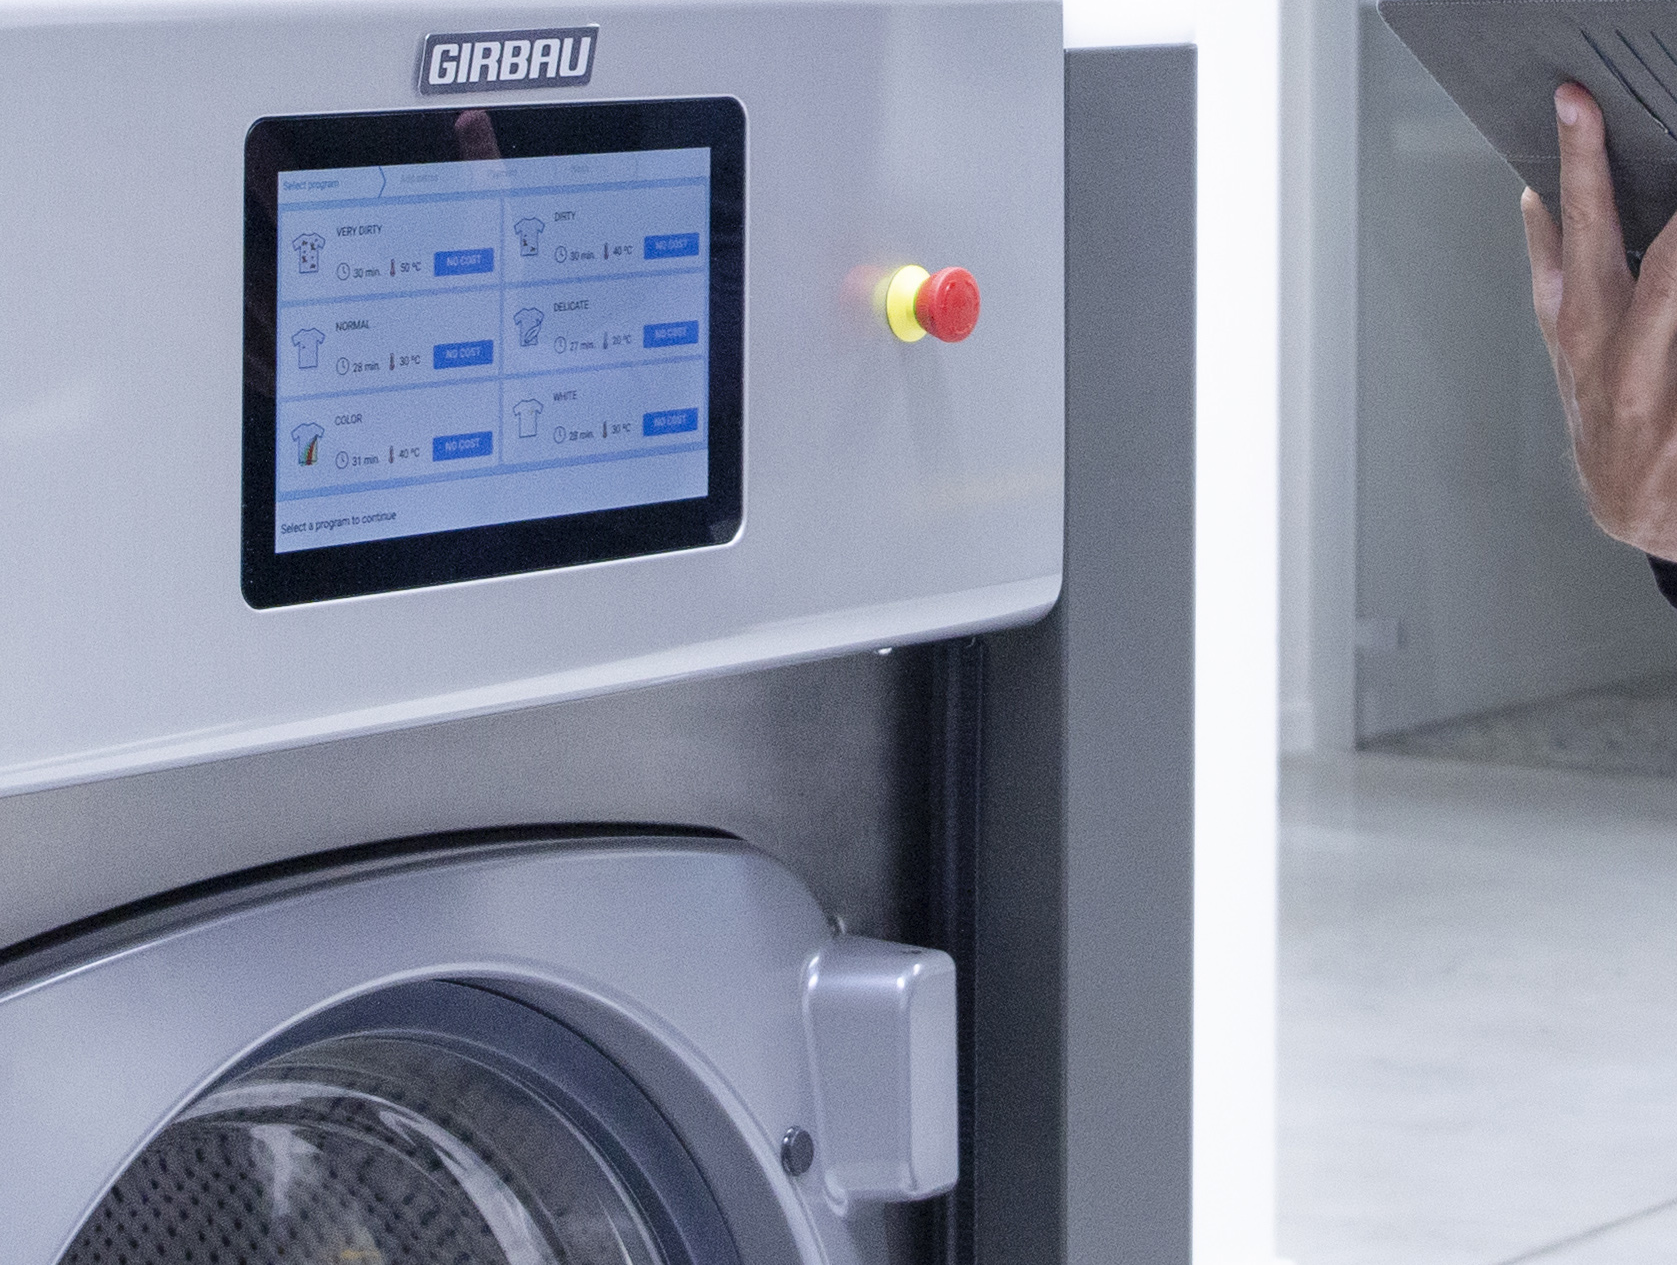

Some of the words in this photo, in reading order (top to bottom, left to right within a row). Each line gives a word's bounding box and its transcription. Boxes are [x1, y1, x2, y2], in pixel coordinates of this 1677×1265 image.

[427, 36, 593, 86] GIRBAU
[308, 180, 340, 191] program
[554, 211, 576, 222] DIRTY
[336, 226, 357, 238] VERY
[359, 224, 383, 236] DIRTY
[446, 256, 459, 266] NO
[460, 254, 482, 266] COST
[353, 268, 364, 279] 30
[400, 262, 410, 273] 50
[554, 300, 590, 312] DELICATE
[336, 320, 370, 332] NORMAL
[570, 341, 579, 351] 27
[445, 349, 458, 359] NO
[459, 347, 481, 358] COST
[399, 356, 410, 366] 30
[353, 362, 363, 373] 28
[553, 390, 578, 402] WHITE
[335, 414, 363, 426] COLOR
[445, 441, 458, 451] NO
[459, 438, 480, 450] COST
[399, 448, 409, 459] 40
[352, 455, 362, 467] 31
[281, 521, 307, 535] Select
[308, 523, 314, 531] a
[315, 517, 350, 532] program
[352, 515, 360, 525] to
[362, 511, 397, 524] continue
